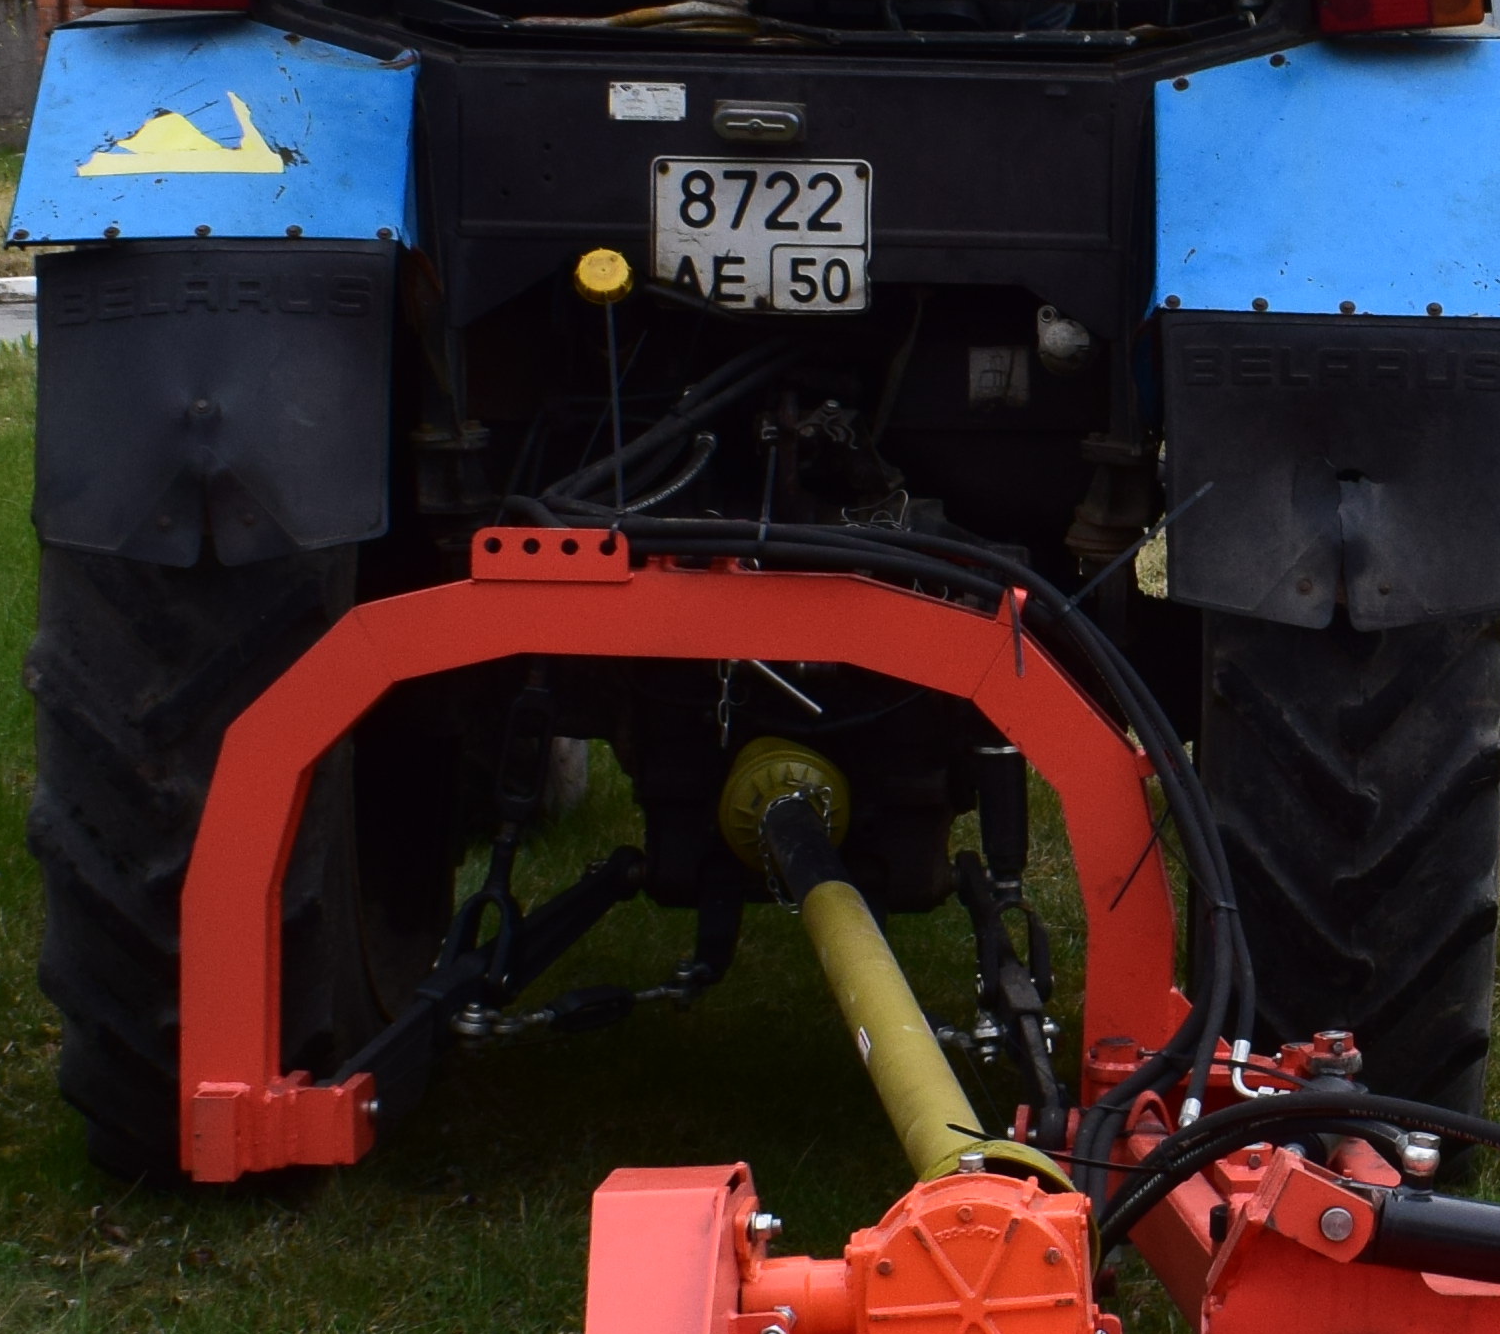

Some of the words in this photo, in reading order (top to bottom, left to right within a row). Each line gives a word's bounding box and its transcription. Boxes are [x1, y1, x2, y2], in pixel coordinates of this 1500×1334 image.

[679, 169, 843, 232] 8722
[56, 272, 373, 327] BELARUS
[789, 257, 851, 304] 50
